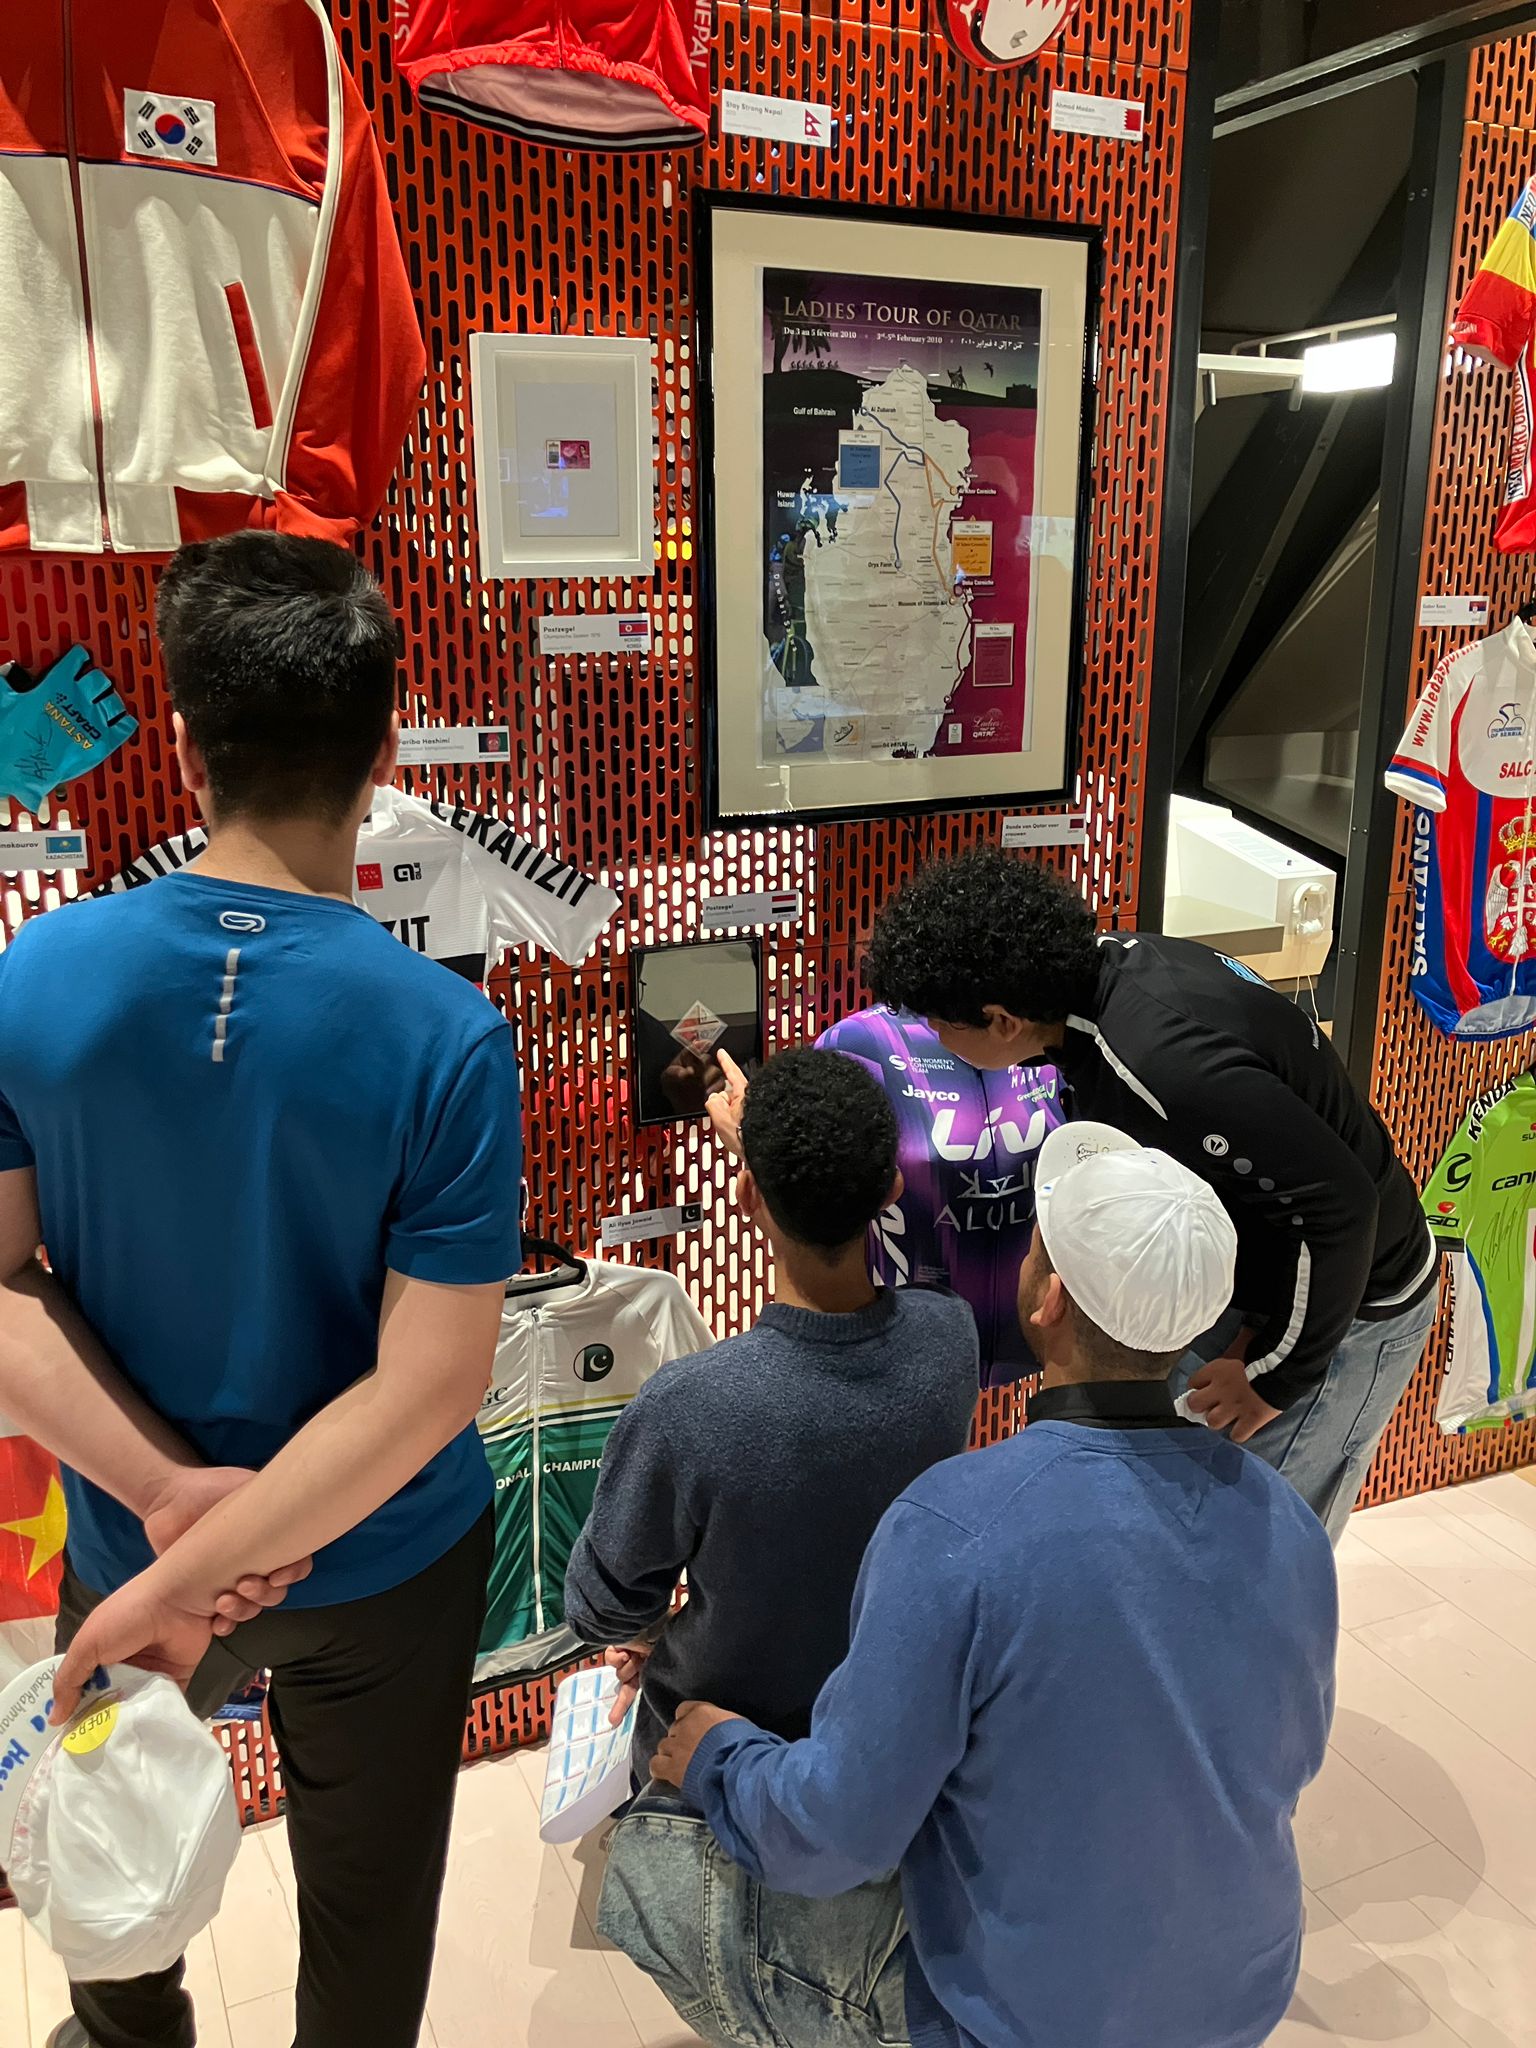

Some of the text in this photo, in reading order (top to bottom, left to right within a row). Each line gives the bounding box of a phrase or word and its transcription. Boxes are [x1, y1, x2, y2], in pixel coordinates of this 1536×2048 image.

[784, 297, 1021, 332] LADIES TOUR OF QATAR
[784, 327, 795, 335] Du
[840, 331, 857, 339] 2010
[926, 336, 943, 344] 2010
[793, 407, 836, 416] Gulf of Bahrain
[44, 701, 93, 749] ASTANA
[63, 704, 101, 740] CRAFT
[1499, 760, 1536, 779] SALC
[430, 798, 597, 907] CERATIZIT
[1412, 812, 1430, 976] SALCANO
[902, 1084, 960, 1103] Jayco
[1468, 1081, 1517, 1141] KENDA
